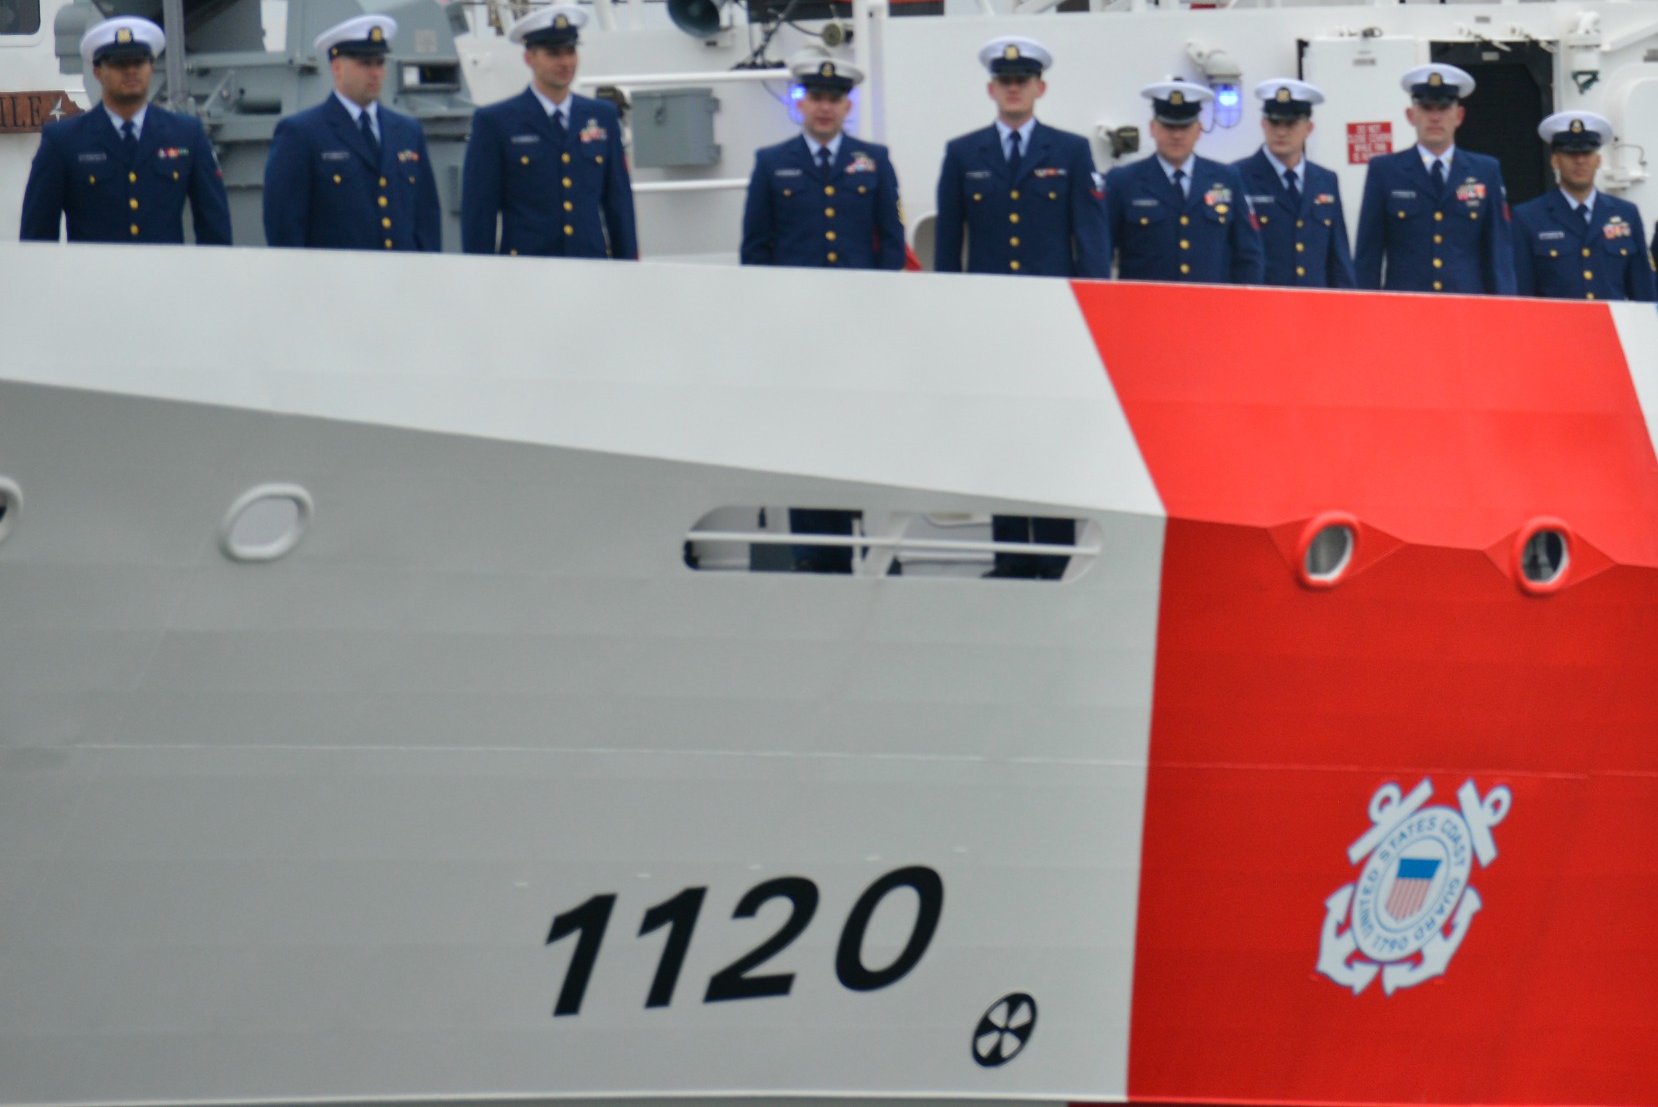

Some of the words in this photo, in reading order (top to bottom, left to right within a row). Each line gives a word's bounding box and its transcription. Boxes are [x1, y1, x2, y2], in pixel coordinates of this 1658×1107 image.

[1379, 815, 1437, 863] STATES
[1440, 818, 1466, 867] COAST
[1359, 869, 1379, 940] UNITED
[1413, 877, 1461, 941] GUARD
[544, 865, 944, 1017] 1120
[1373, 933, 1409, 953] 1790
